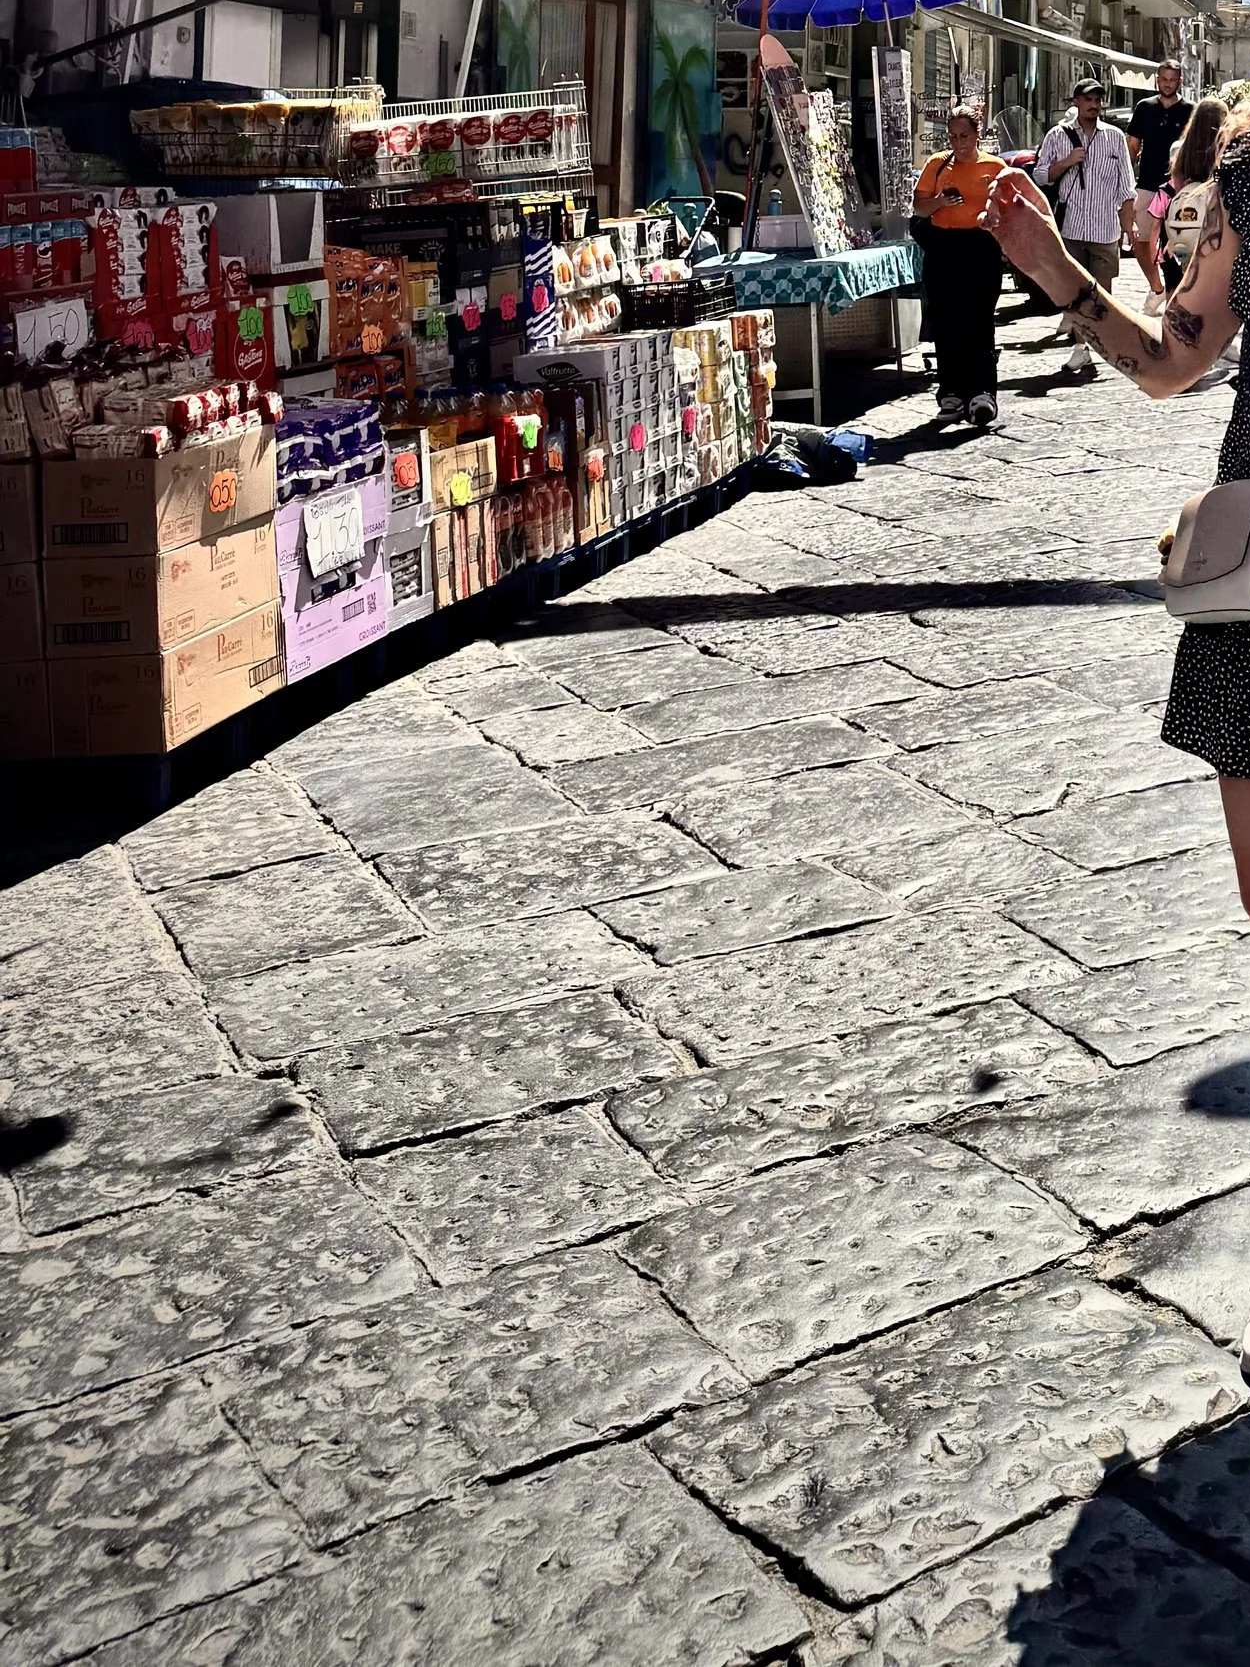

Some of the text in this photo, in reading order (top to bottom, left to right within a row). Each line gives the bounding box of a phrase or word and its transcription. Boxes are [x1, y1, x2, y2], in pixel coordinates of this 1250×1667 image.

[541, 363, 576, 377] Valfrutta
[125, 468, 147, 484] 16
[127, 566, 147, 582] 16
[261, 610, 275, 632] 16
[358, 620, 387, 642] CROISSANT
[134, 664, 155, 680] 16
